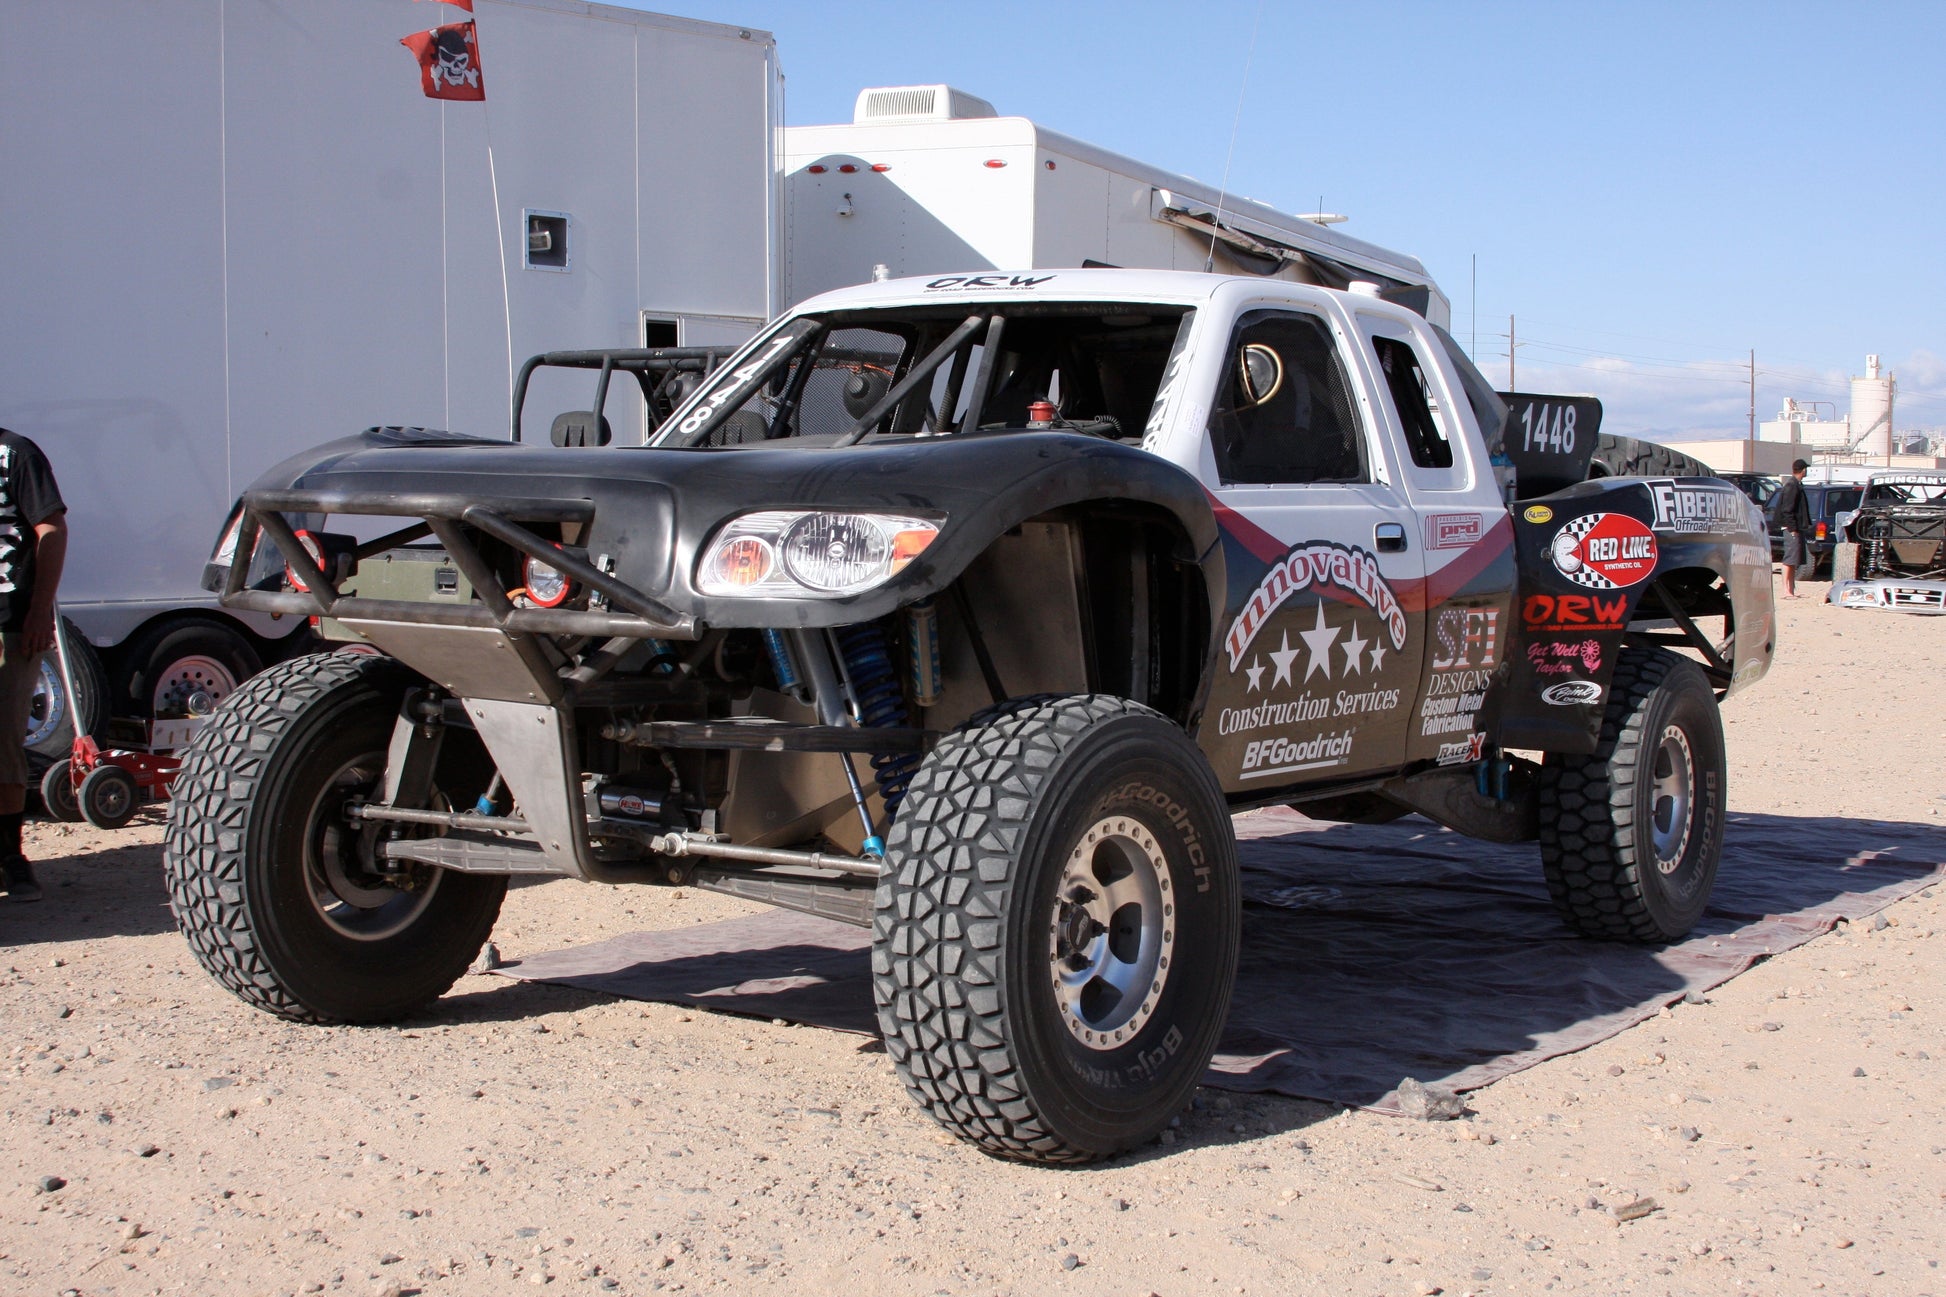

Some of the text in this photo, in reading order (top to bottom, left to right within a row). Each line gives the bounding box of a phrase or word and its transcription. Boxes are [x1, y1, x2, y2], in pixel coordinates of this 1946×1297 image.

[926, 275, 1057, 289] ORW
[680, 335, 794, 434] 1448
[1521, 402, 1577, 454] 1448
[1873, 476, 1938, 485] DUNCAN
[1675, 519, 1709, 532] Offroad
[1589, 536, 1652, 562] RED LINE
[1604, 561, 1643, 571] SYNTHETIC OIL
[1226, 546, 1406, 672] Innovative
[1523, 594, 1627, 624] ORW
[1433, 608, 1500, 669] SFI
[1527, 642, 1580, 659] Get Well
[1533, 659, 1573, 675] Taylor
[1426, 669, 1492, 696] DESIGNS
[1219, 682, 1400, 736] Construction Services
[1421, 692, 1486, 717] Custom Metal
[1422, 712, 1474, 736] Fabrication
[1241, 729, 1353, 769] BFGoodrich
